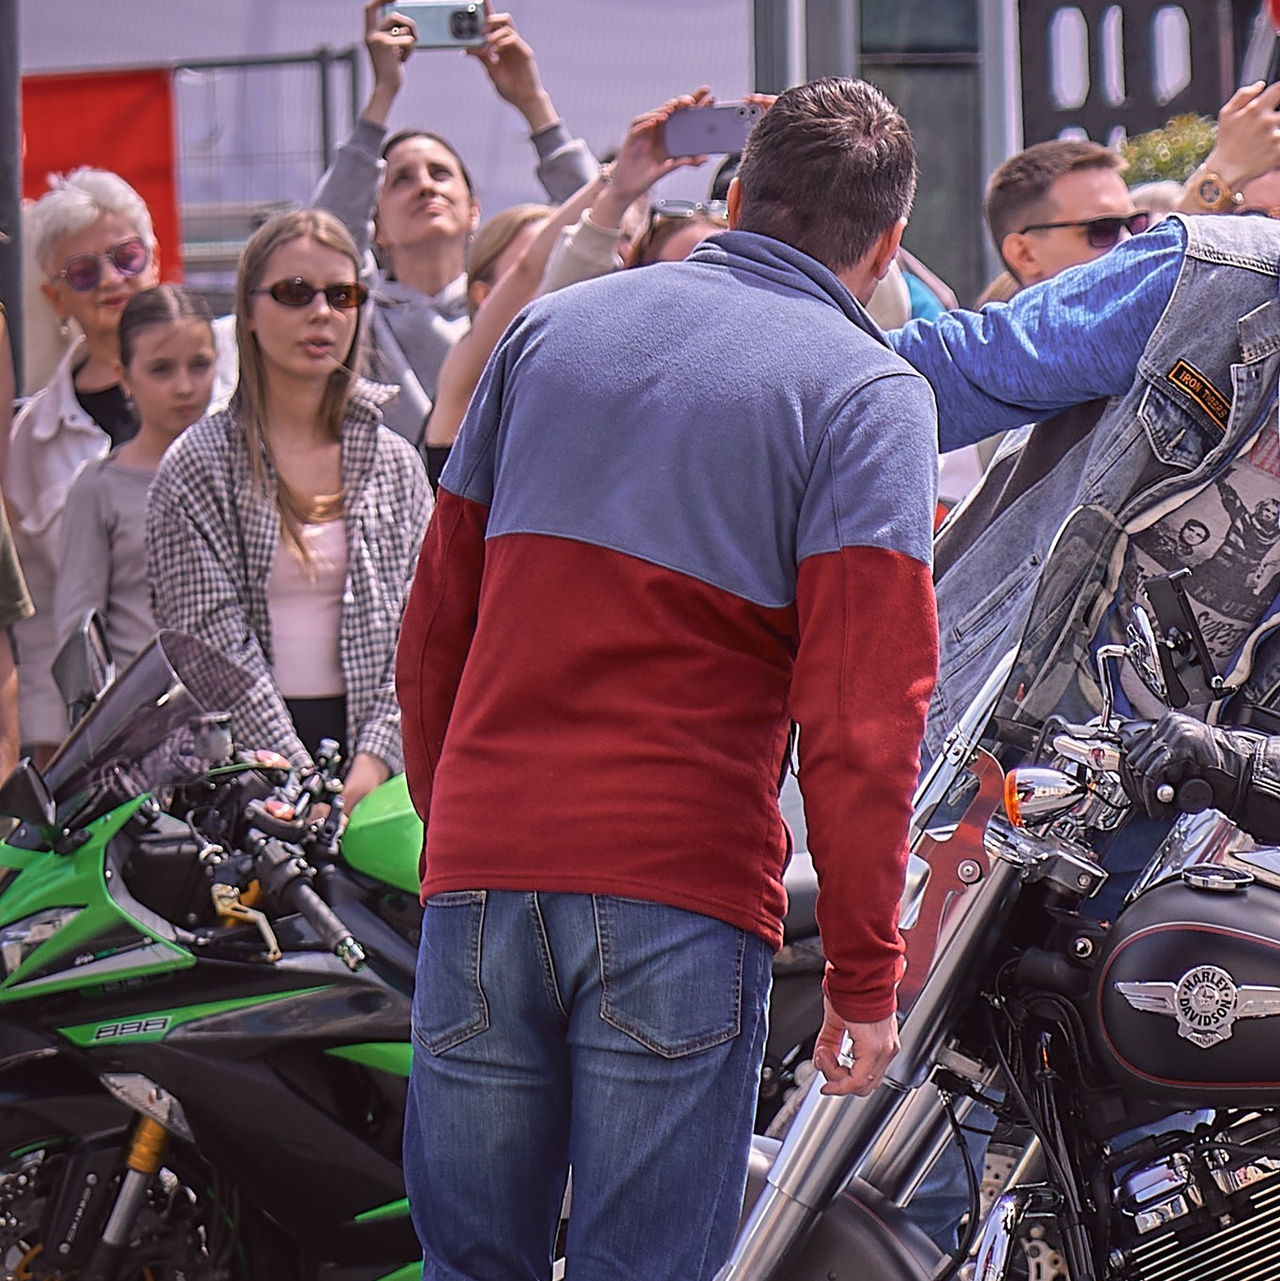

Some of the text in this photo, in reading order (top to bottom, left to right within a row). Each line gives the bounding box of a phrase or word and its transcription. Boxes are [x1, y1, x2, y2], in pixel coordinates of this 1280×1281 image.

[1179, 370, 1203, 393] IRON
[1182, 971, 1231, 992] HARLEY
[1180, 998, 1232, 1027] DAVIDSON
